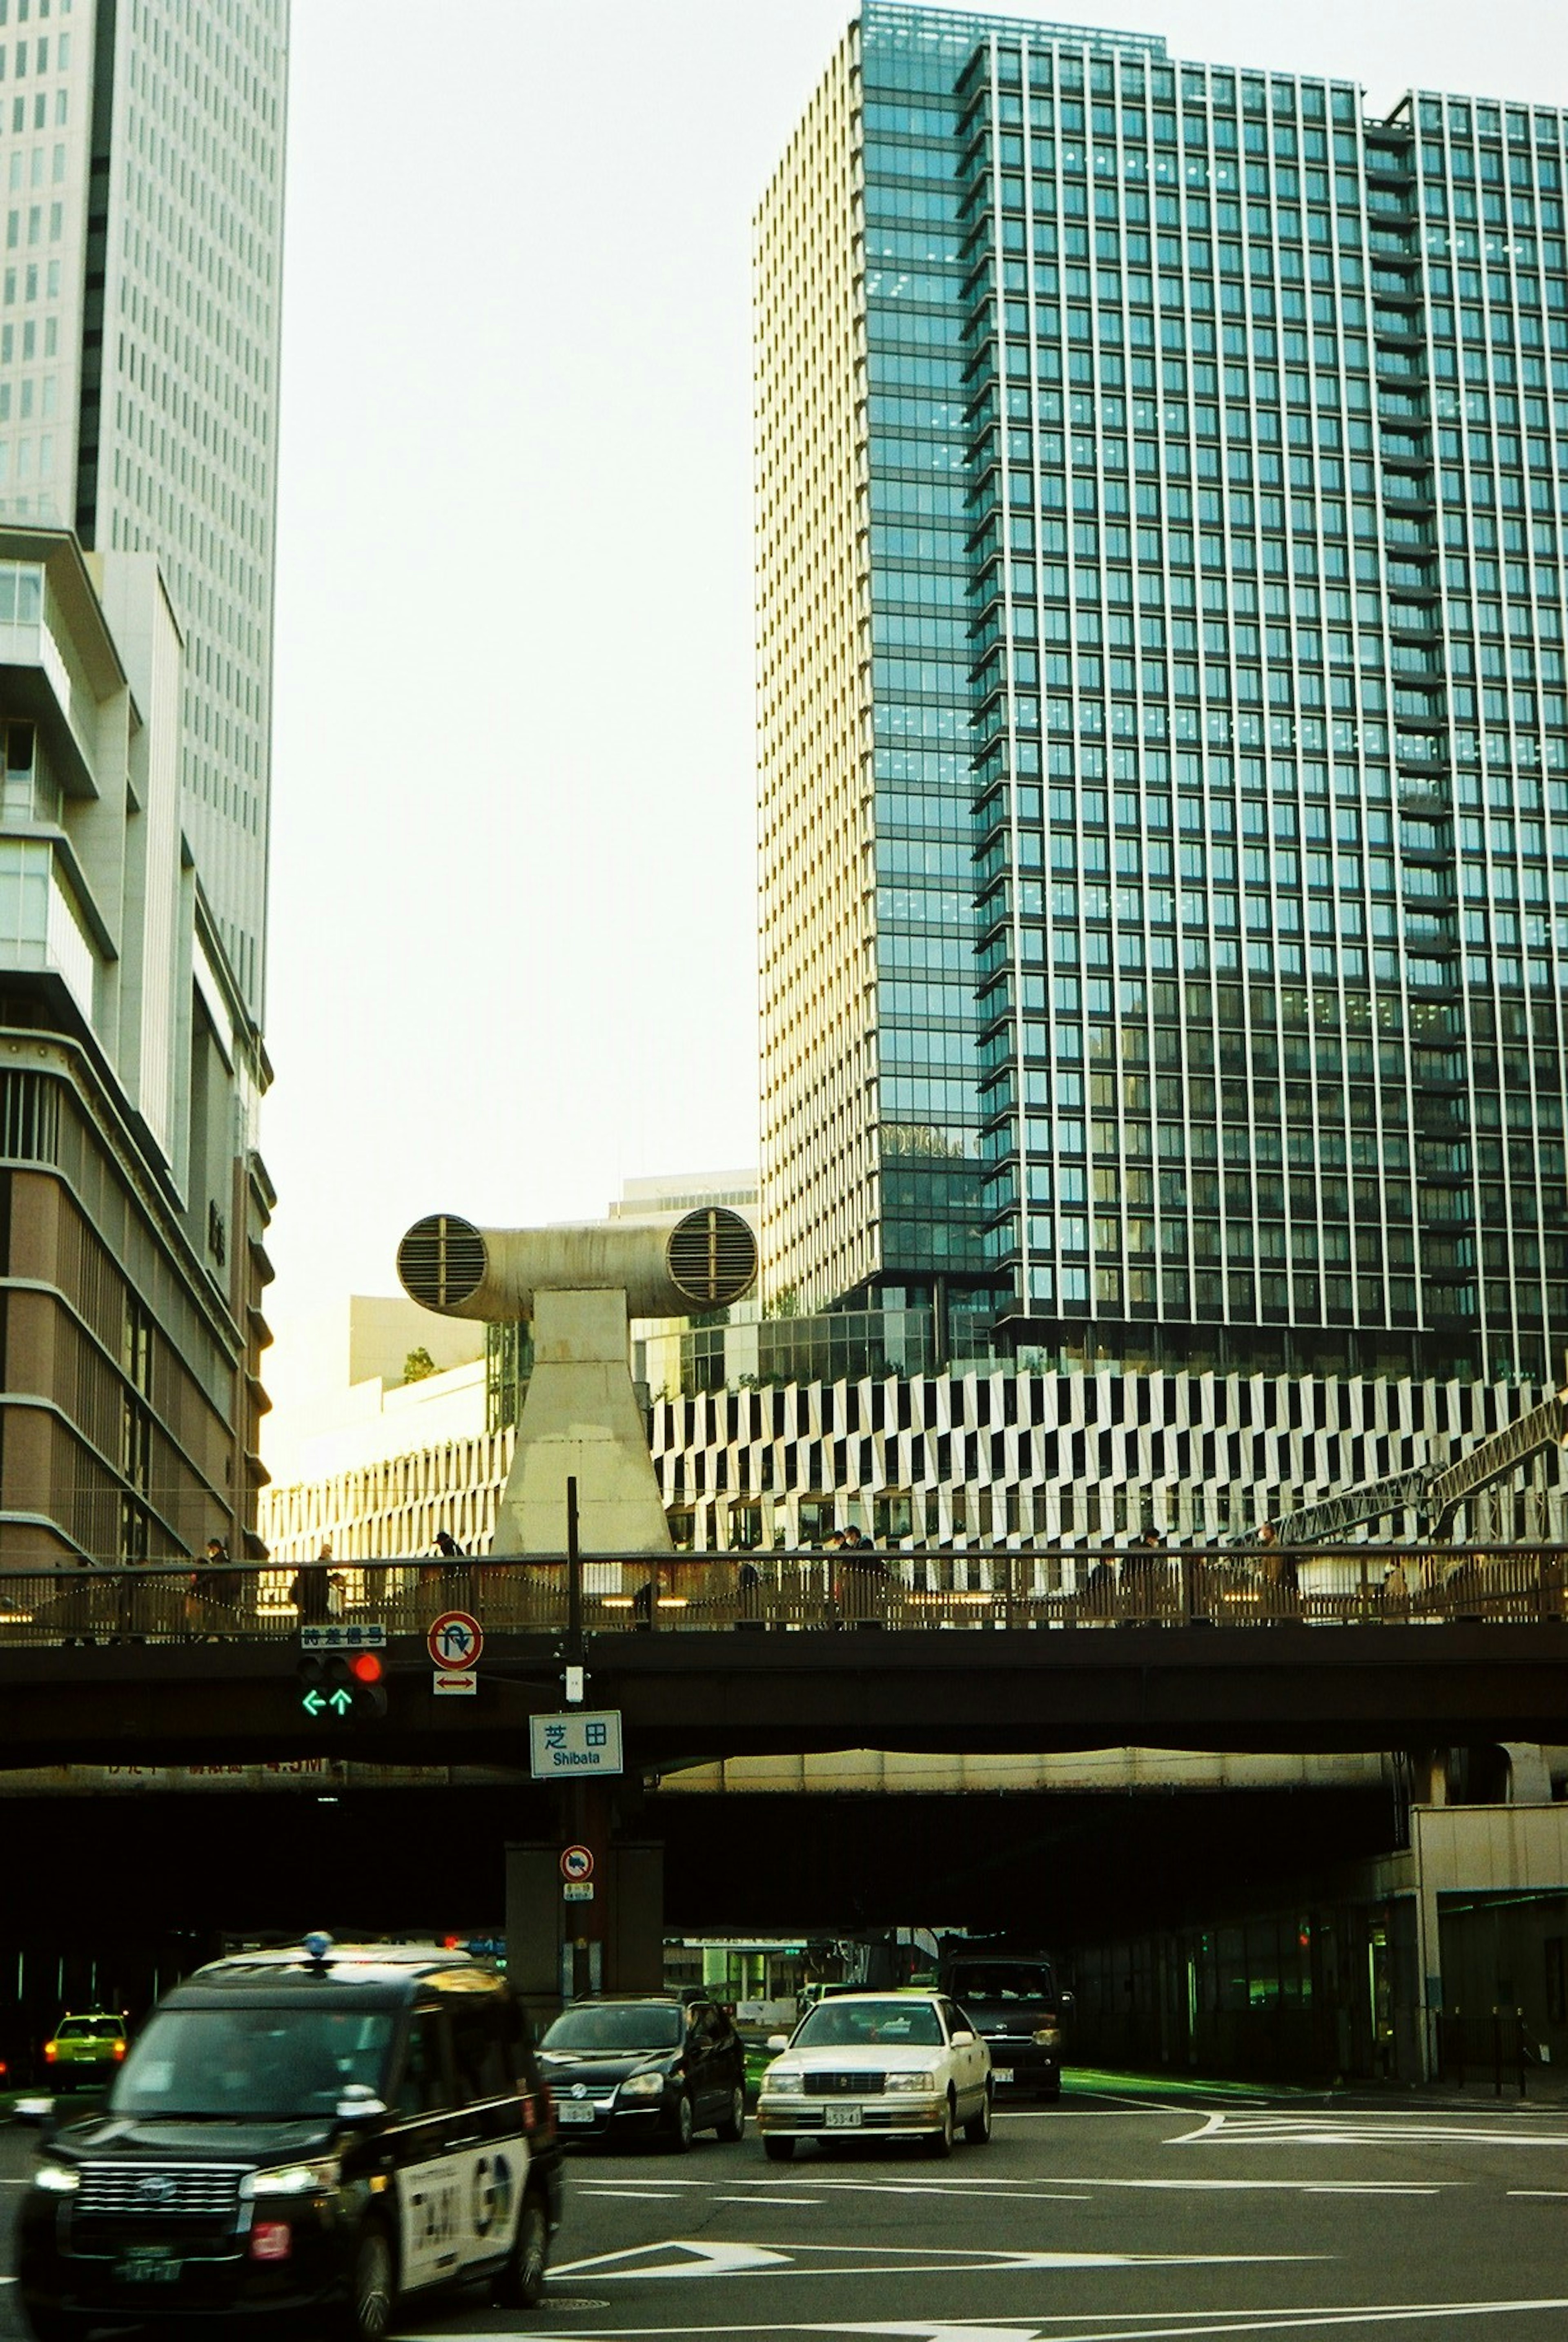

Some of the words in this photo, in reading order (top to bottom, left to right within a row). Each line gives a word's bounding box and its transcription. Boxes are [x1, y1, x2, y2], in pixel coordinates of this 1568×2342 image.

[304, 1627, 383, 1645] 時差信号
[545, 1723, 606, 1749] 芝田
[554, 1752, 600, 1765] Shibata
